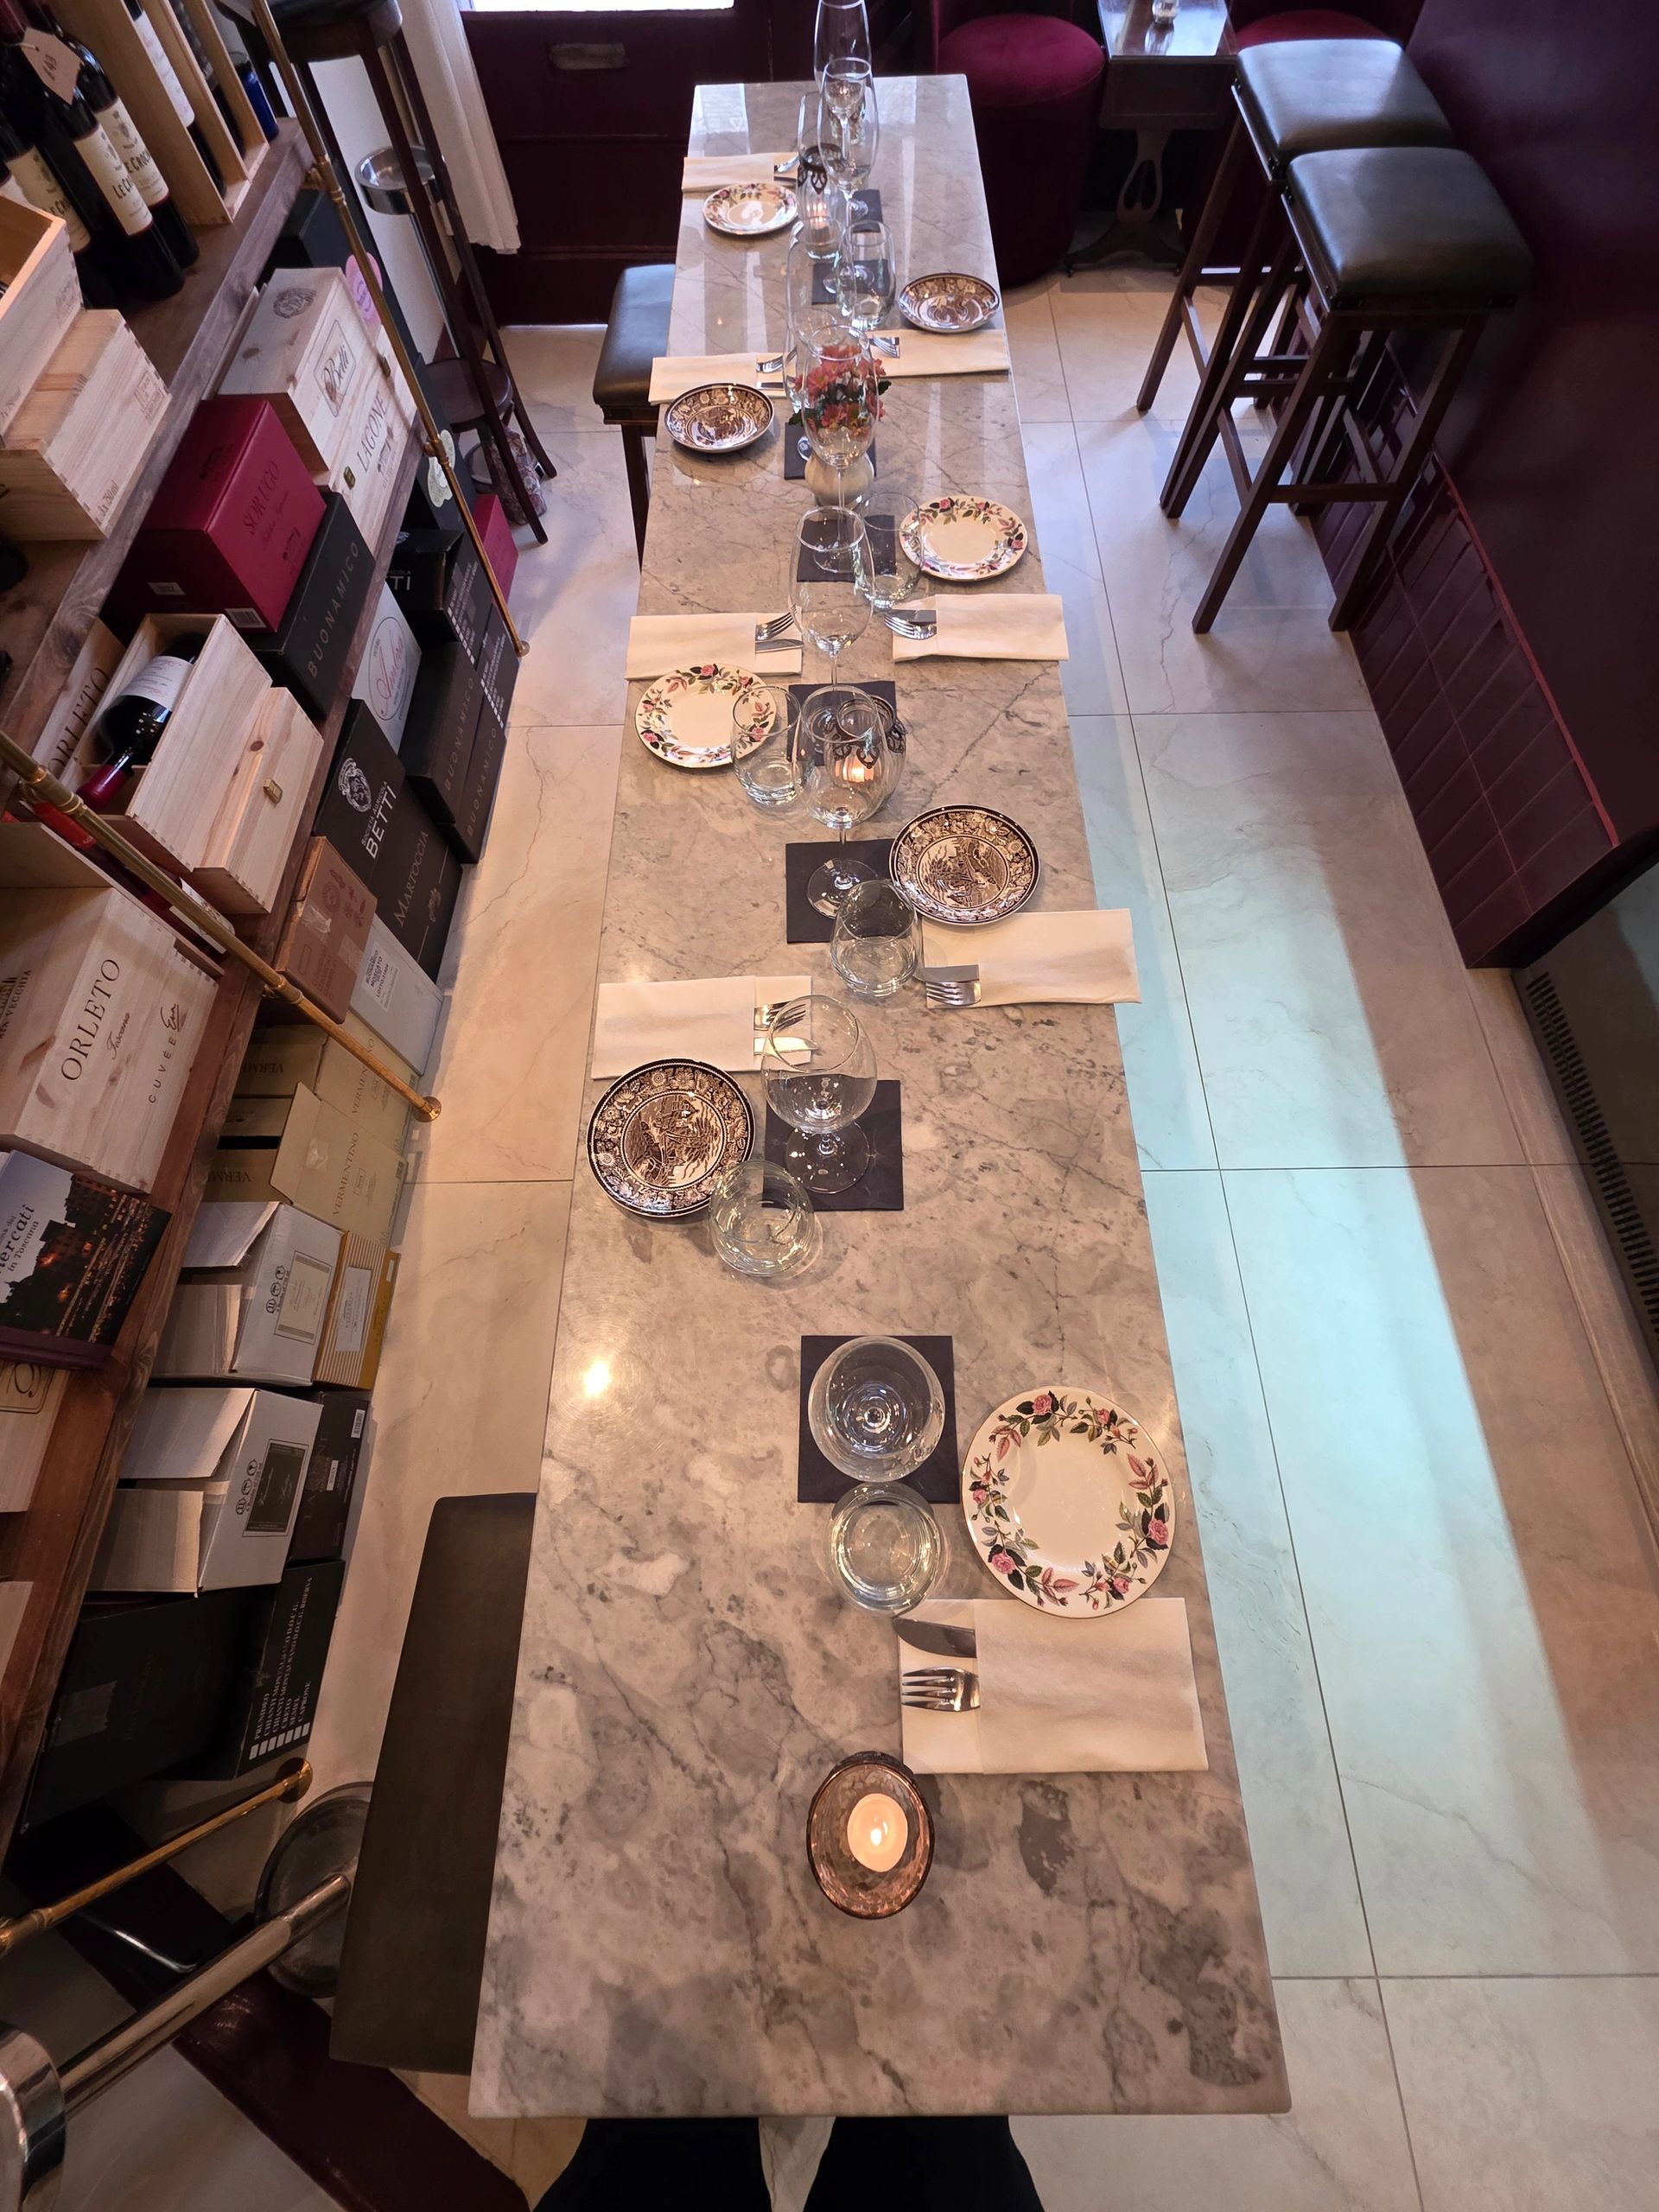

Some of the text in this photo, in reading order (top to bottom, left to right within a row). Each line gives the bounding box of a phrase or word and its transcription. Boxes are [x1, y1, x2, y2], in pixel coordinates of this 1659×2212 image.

[356, 390, 387, 474] LAGONE
[308, 540, 360, 679] BUONAMICO
[444, 676, 475, 791] BUONAMICO
[365, 784, 397, 860] BETTI
[467, 727, 498, 837] BUONAMICO
[393, 830, 429, 928] MARTOCCIA
[60, 958, 121, 1081] ORLETO
[148, 1036, 178, 1104] CUVÉE
[332, 1131, 360, 1217] VERMENTINO
[8, 1220, 40, 1272] in Toscana
[262, 1697, 277, 1736] CHIANTI
[270, 1697, 285, 1732] CHIANTI
